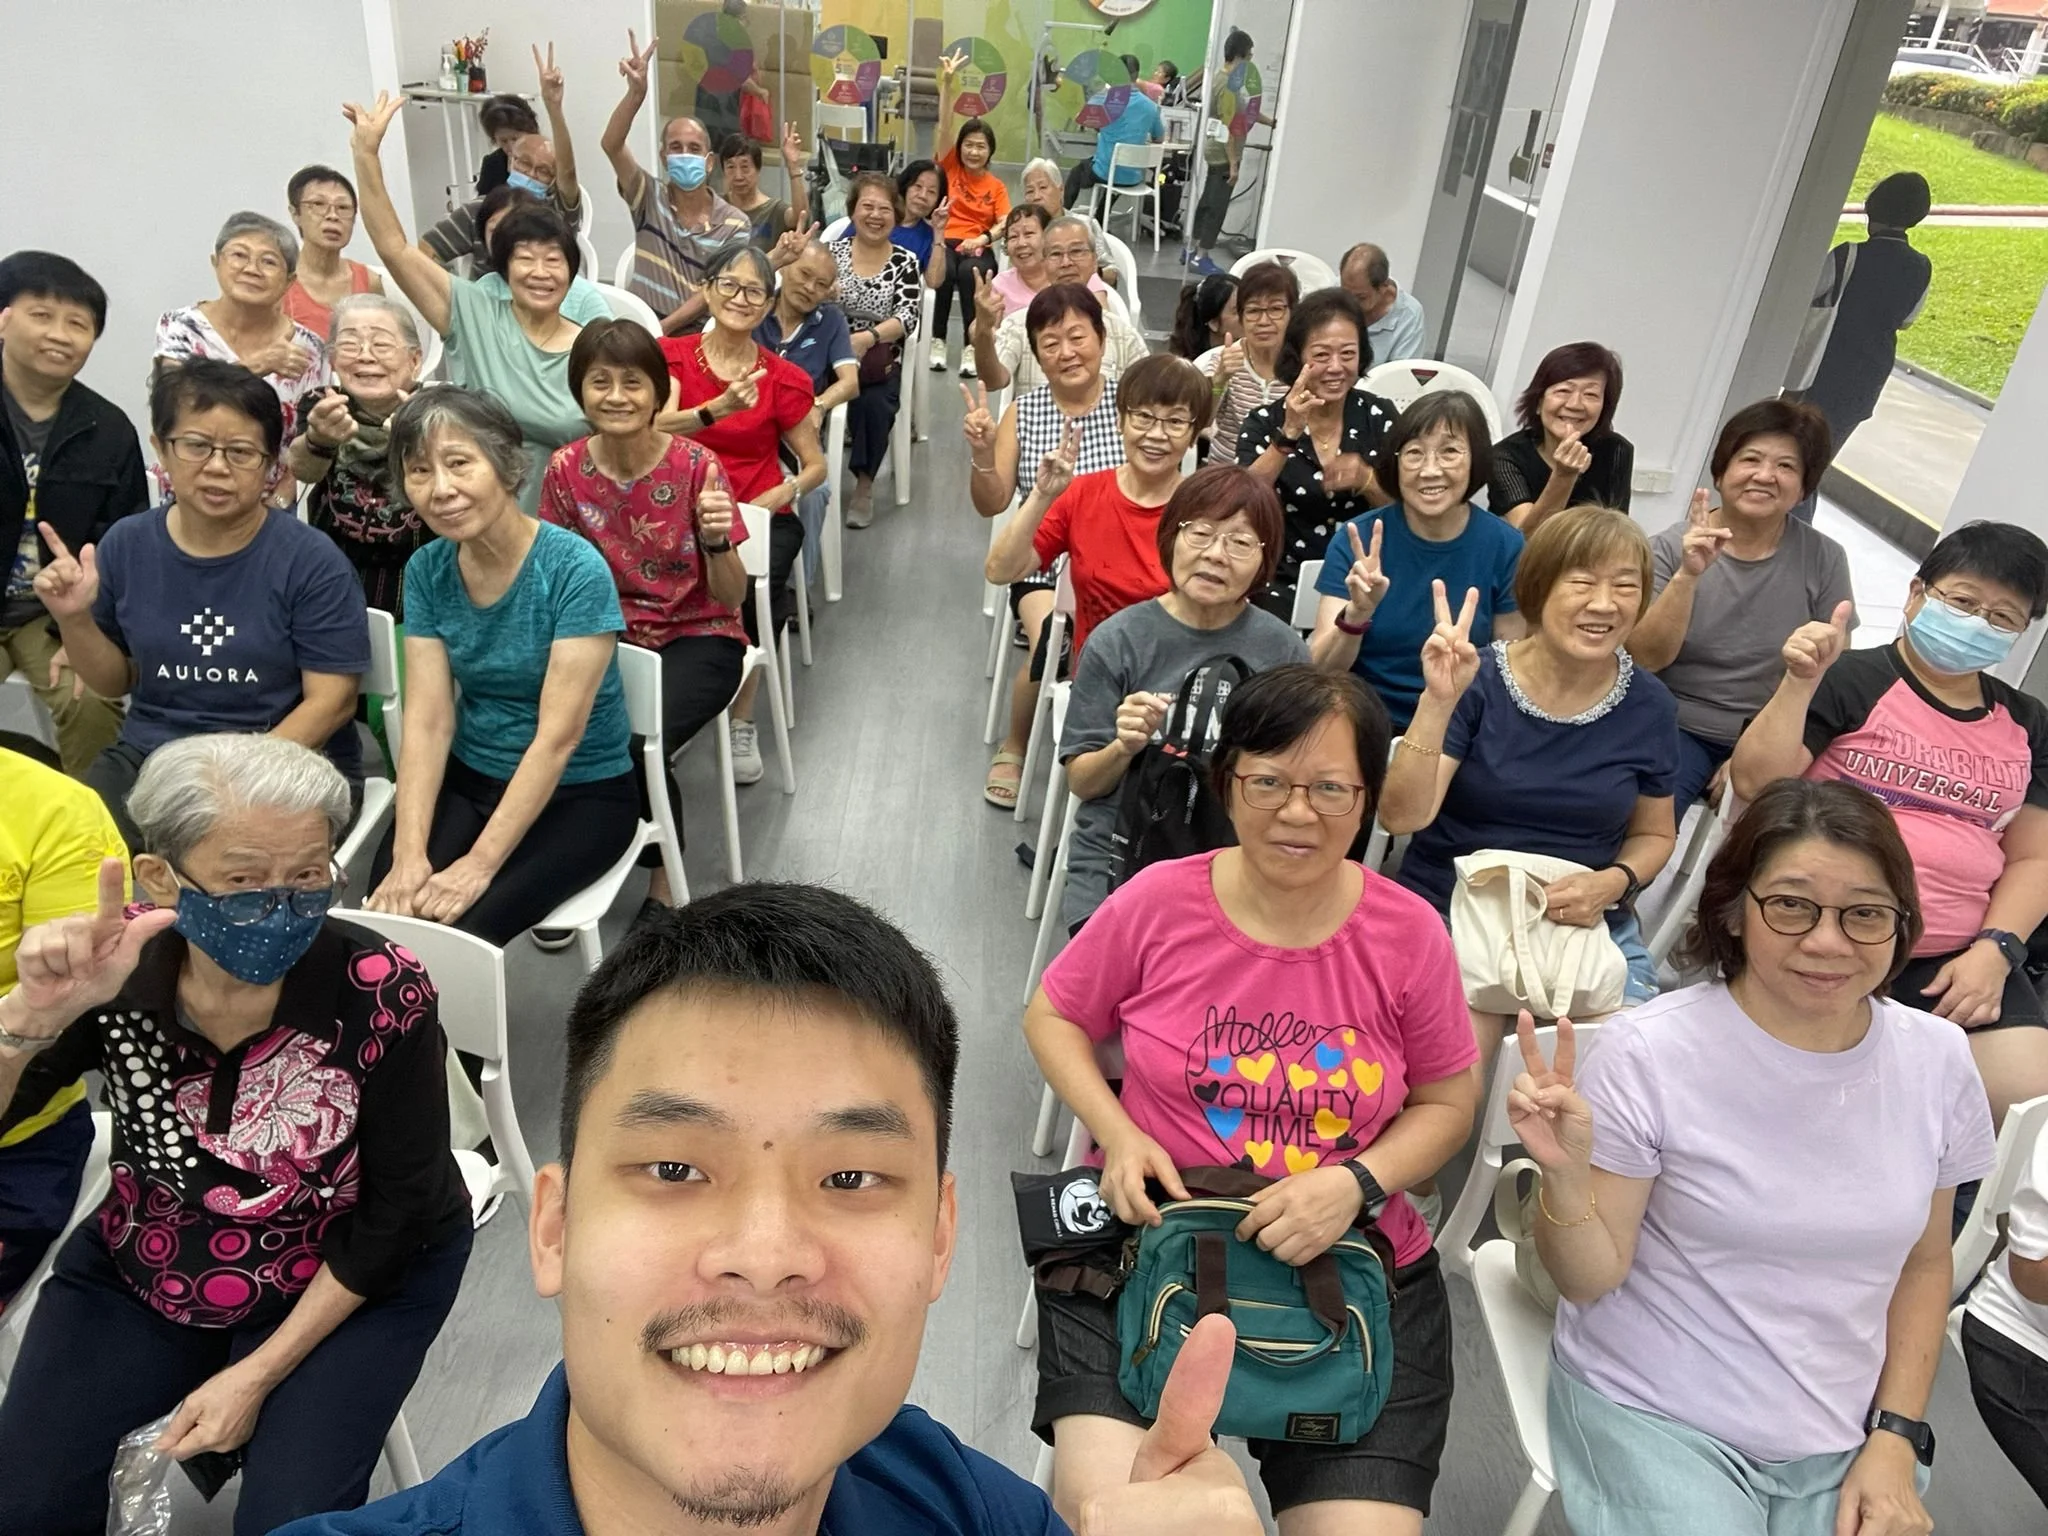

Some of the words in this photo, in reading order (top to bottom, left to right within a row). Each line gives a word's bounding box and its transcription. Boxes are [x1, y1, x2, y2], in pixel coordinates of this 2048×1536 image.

[157, 664, 259, 682] AULORA
[1846, 750, 2003, 813] UNIVERSAL
[1220, 1082, 1360, 1119] QUALITY
[1245, 1113, 1321, 1148] TIME
